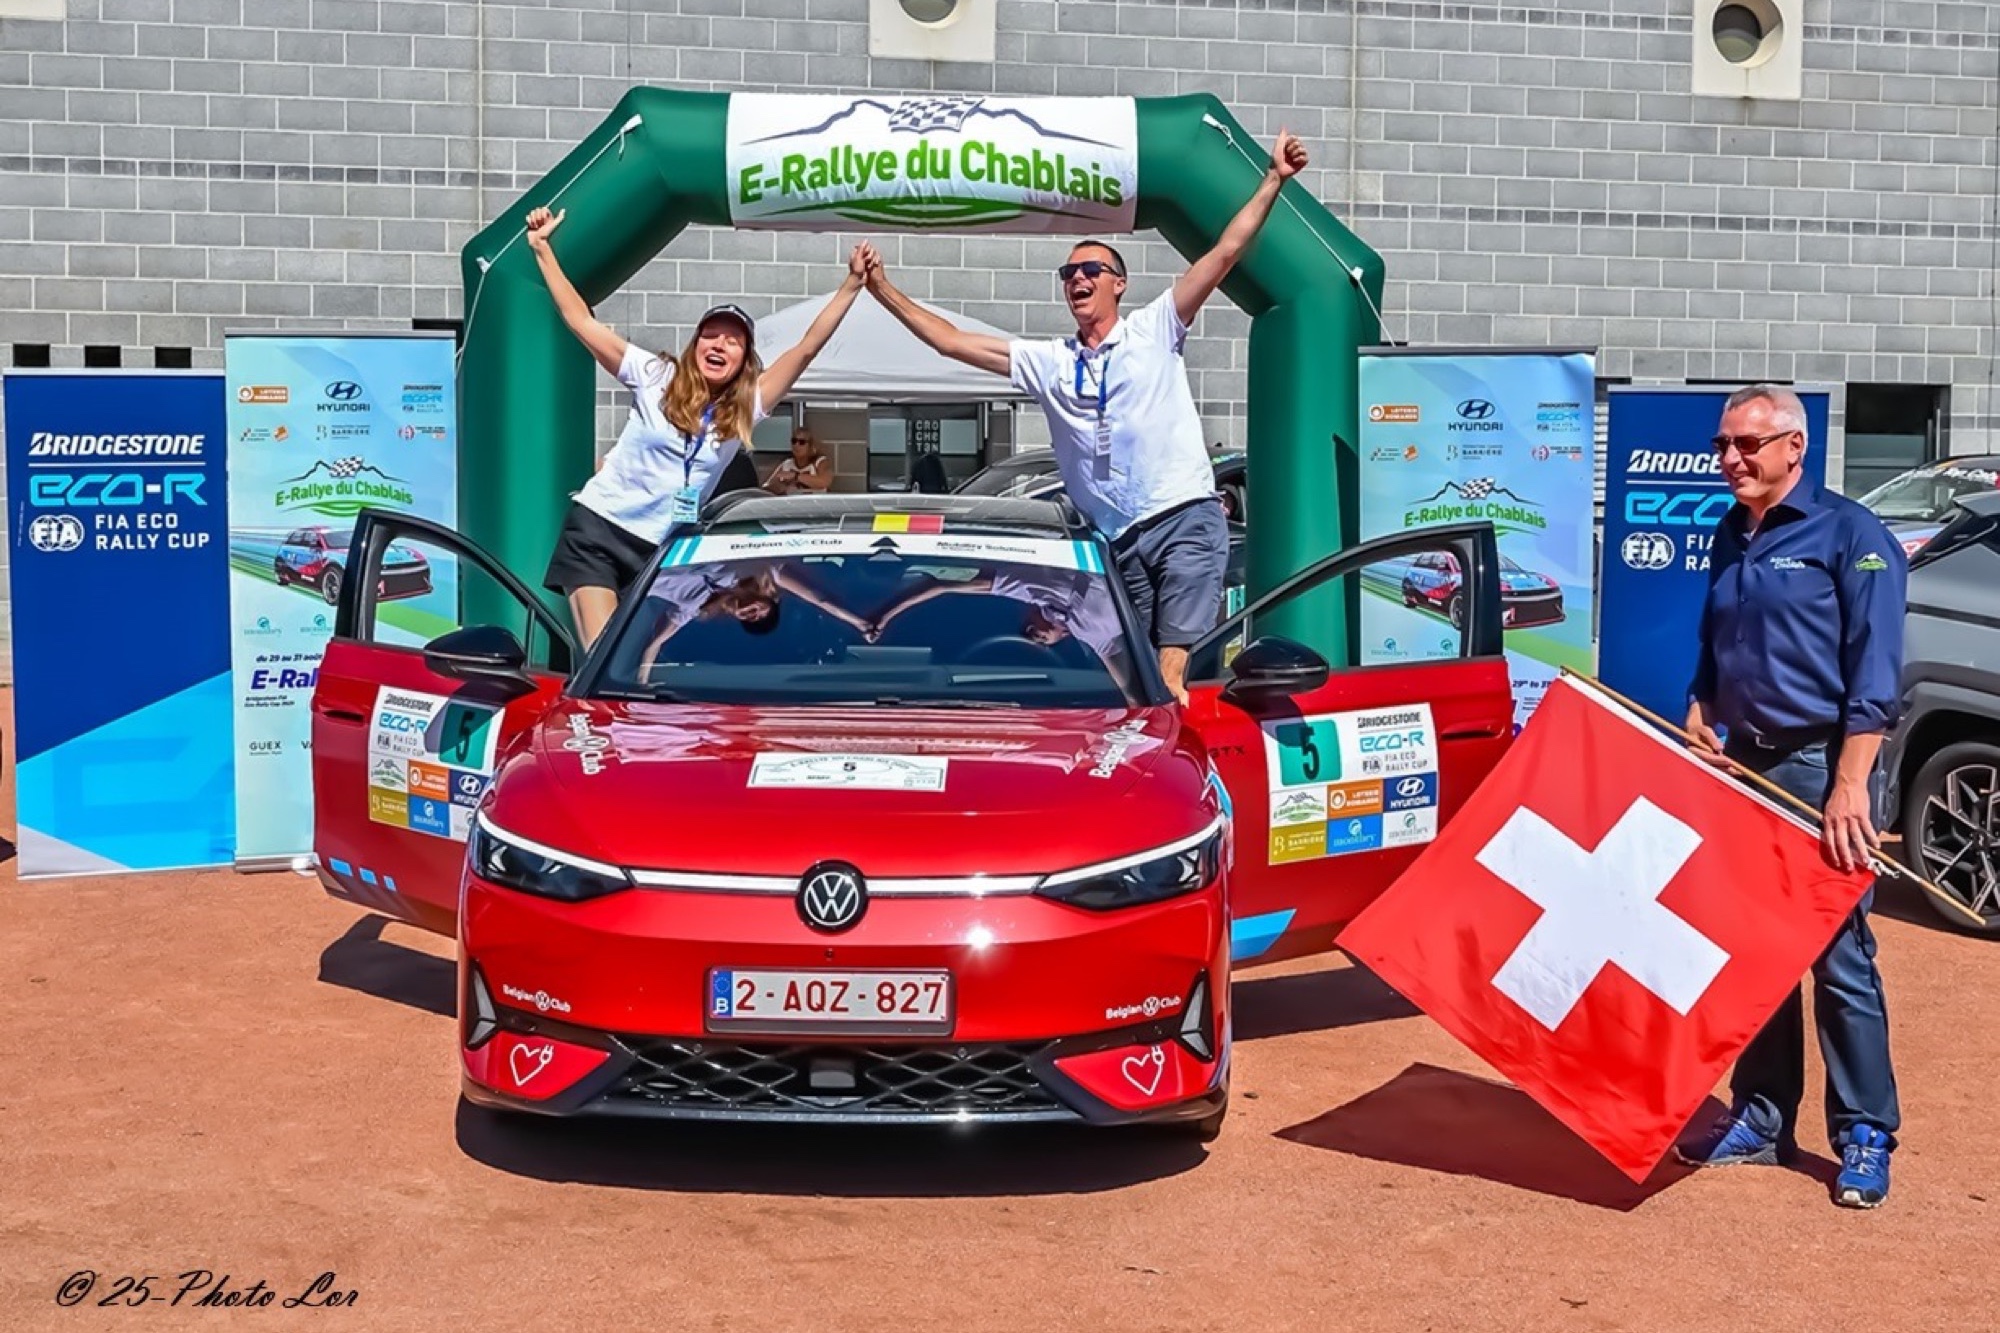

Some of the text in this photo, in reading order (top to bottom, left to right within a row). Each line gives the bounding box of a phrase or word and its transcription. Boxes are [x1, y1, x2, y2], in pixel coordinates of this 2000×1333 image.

[740, 140, 1123, 207] E-Rallye du Chablais
[1447, 421, 1504, 431] HYUNDAI
[28, 432, 206, 457] BRIDGESTONE
[275, 480, 414, 507] E-Rallye du Chablais
[95, 512, 179, 530] FIA ECO
[1404, 503, 1548, 529] E-Rallye du Chablais
[95, 532, 210, 551] RALLY CUP
[1358, 711, 1421, 729] BRIDGESTONE
[249, 741, 282, 751] GUEX
[455, 710, 475, 763] 5
[1301, 726, 1320, 780] 5
[1400, 750, 1416, 760] ECO
[1386, 759, 1428, 771] RALLY CUP
[502, 984, 536, 1001] Belgian
[550, 997, 571, 1013] Club
[715, 997, 728, 1013] B
[1105, 1005, 1143, 1020] Belgian
[1160, 995, 1182, 1009] Club
